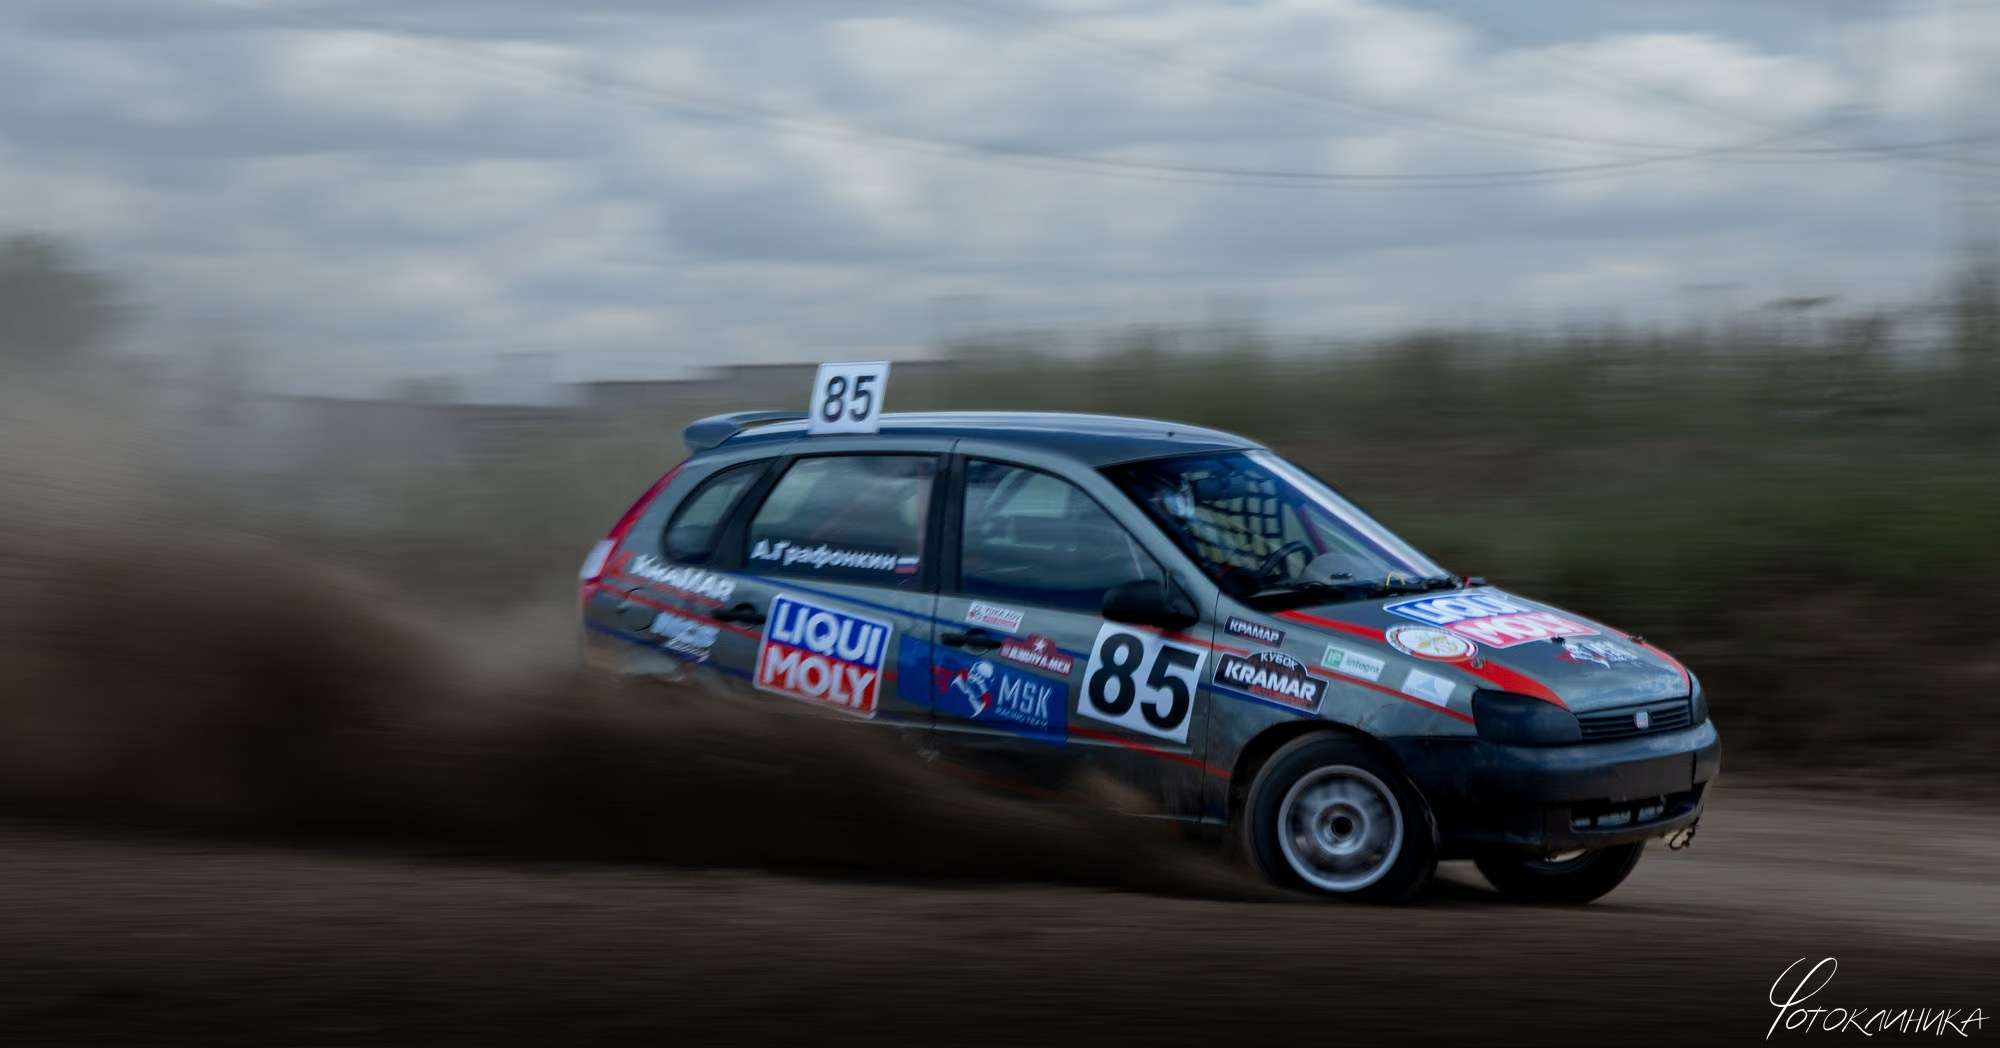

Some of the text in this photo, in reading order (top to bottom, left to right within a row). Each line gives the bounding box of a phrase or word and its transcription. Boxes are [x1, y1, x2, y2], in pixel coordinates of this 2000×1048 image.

[823, 375, 878, 423] 85
[771, 602, 884, 666] LIQUI
[1453, 612, 1584, 646] MOLY
[763, 646, 876, 709] MOLY
[1088, 633, 1200, 731] 85
[1224, 659, 1317, 702] KRAMAR
[1261, 651, 1299, 672] КУБОК
[997, 673, 1053, 720] MSK
